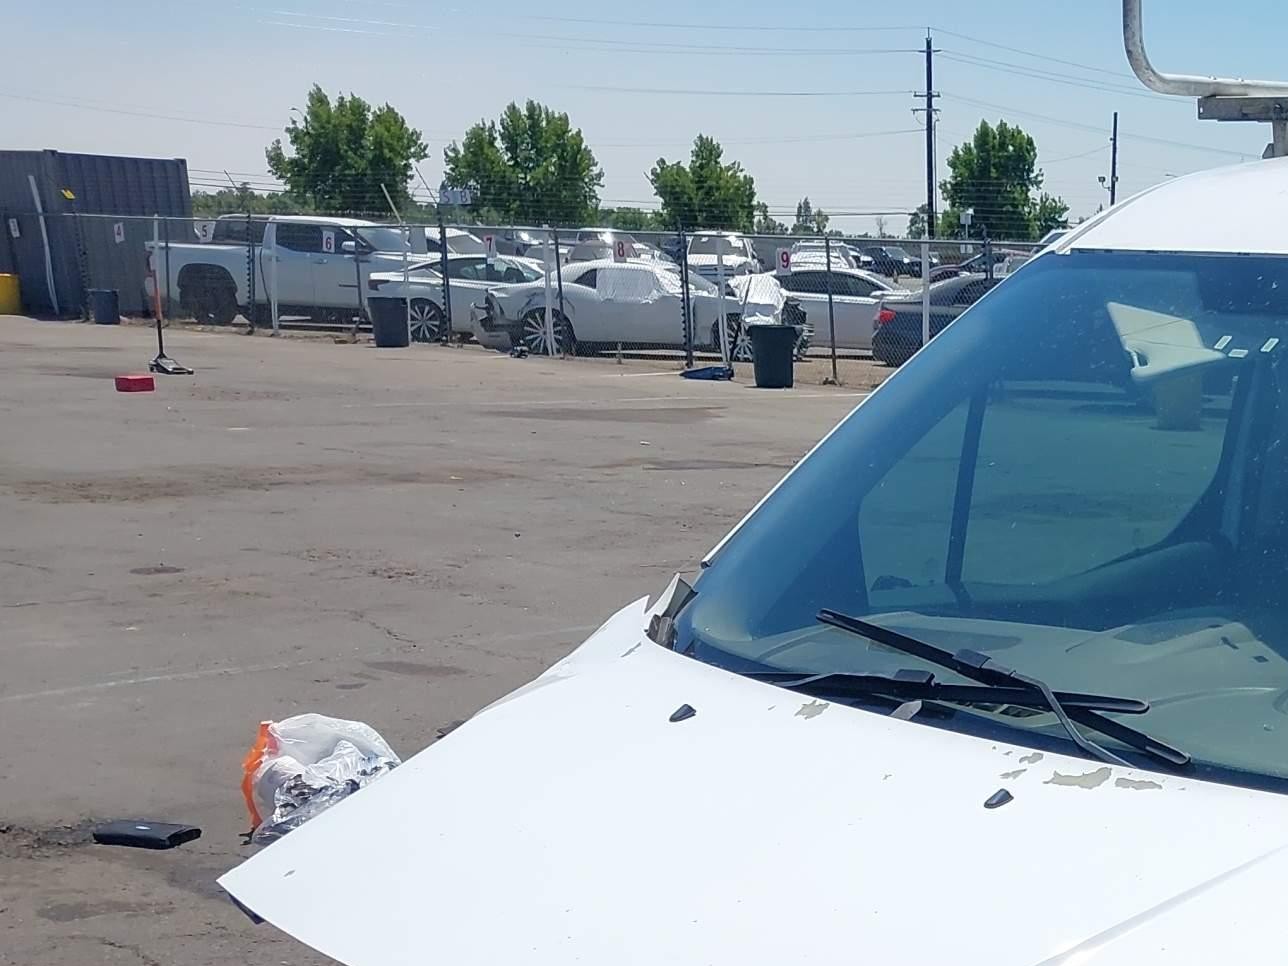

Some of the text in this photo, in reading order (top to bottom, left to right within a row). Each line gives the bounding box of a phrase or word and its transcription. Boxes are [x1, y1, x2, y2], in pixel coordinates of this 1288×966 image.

[201, 224, 208, 238] 5
[325, 236, 332, 250] 6
[485, 236, 493, 252] 7
[617, 241, 625, 257] 8
[780, 251, 790, 268] 9
